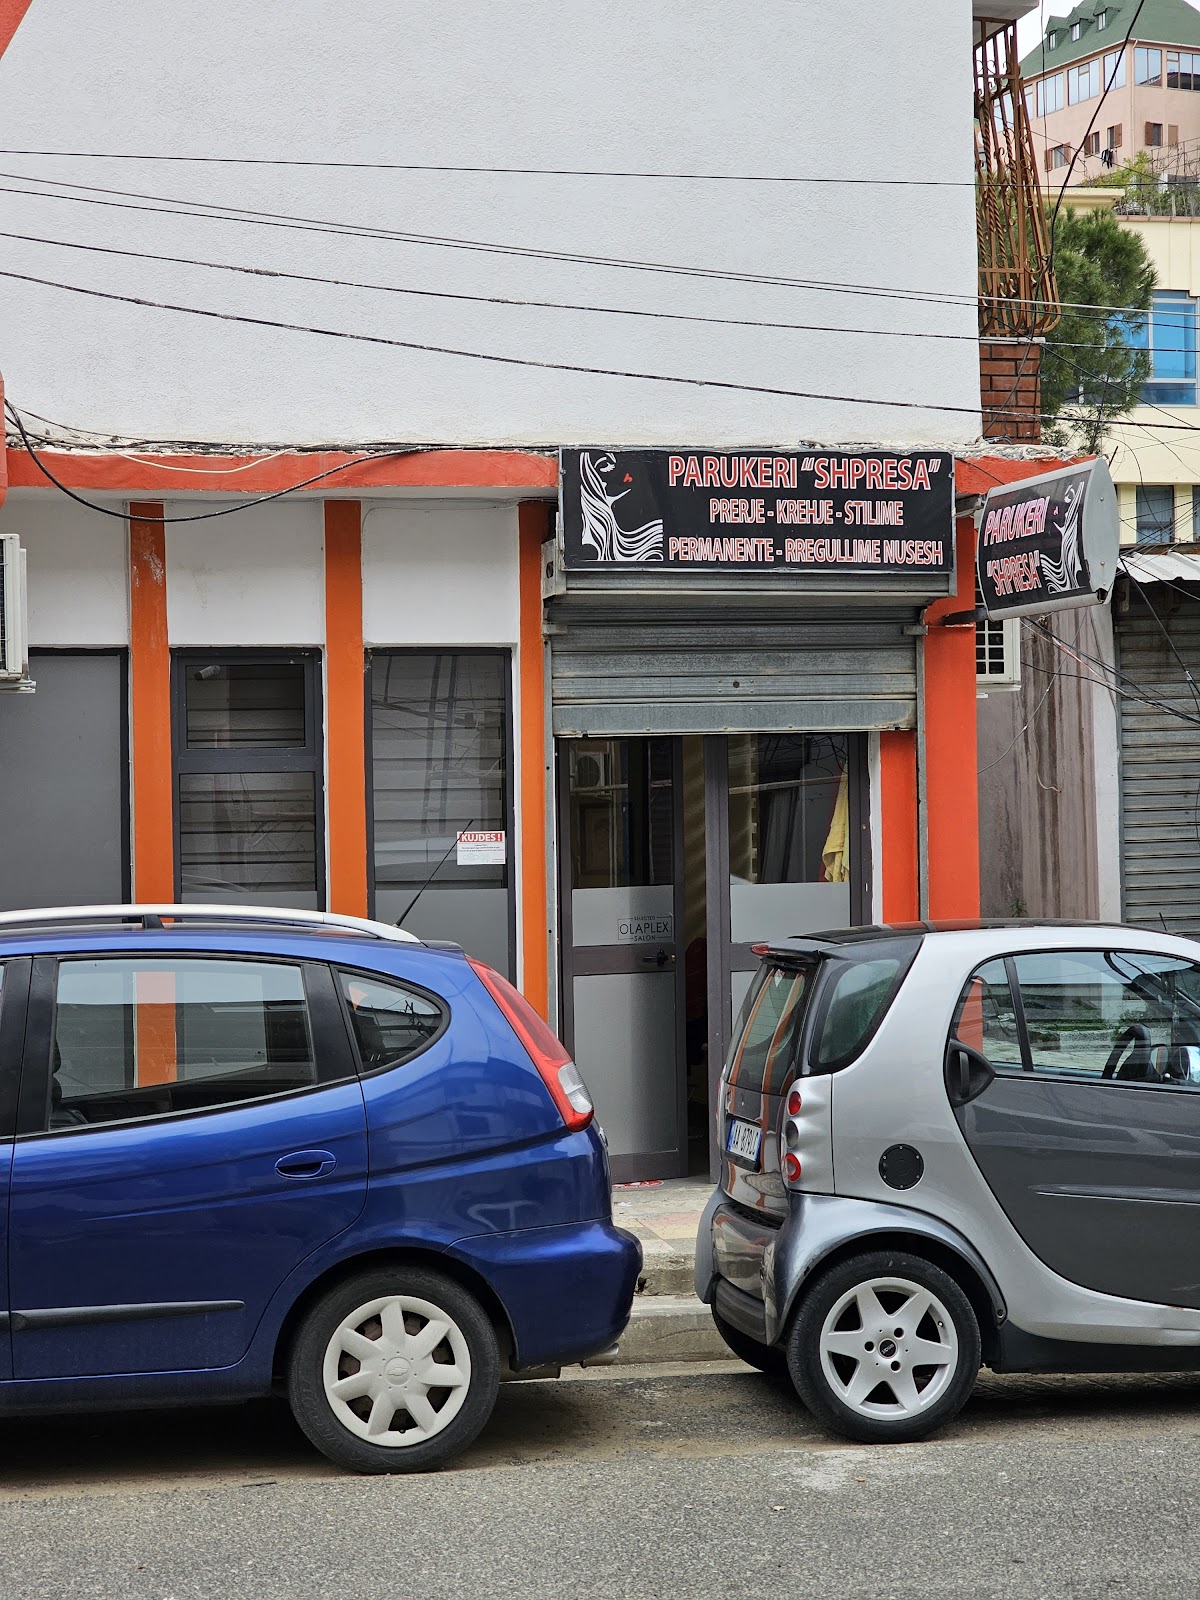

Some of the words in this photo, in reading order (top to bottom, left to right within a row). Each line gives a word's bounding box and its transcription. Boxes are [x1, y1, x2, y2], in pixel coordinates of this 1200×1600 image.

[668, 456, 798, 489] PARUKERI
[801, 458, 941, 491] “SHPRESA”
[709, 498, 765, 524] PRERJE
[776, 500, 833, 525] KREHJE
[844, 500, 904, 526] STILIME
[983, 496, 1050, 546] PARUKERI
[669, 536, 774, 562] PERMANENTE
[784, 538, 881, 564] RREGULLIME
[883, 540, 943, 565] NUSESH
[461, 833, 496, 842] KUJDES
[619, 921, 668, 935] OLAPLEX
